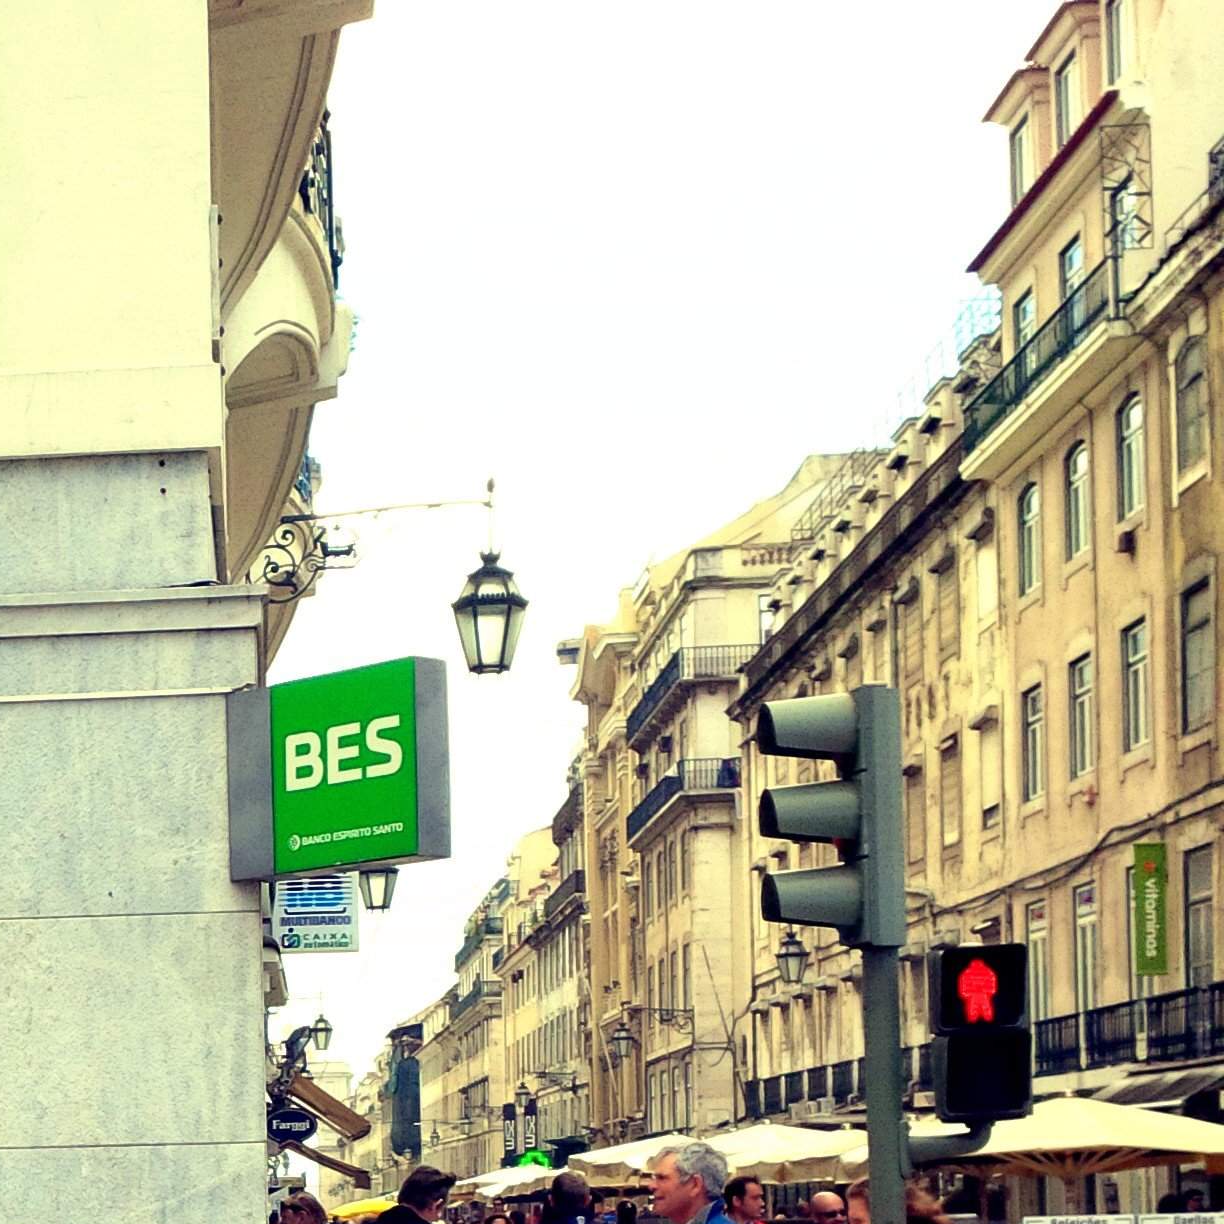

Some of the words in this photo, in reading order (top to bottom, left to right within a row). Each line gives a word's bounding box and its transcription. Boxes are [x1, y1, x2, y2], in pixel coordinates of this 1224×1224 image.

[285, 714, 403, 792] BES
[302, 833, 331, 846] BANCO
[333, 827, 371, 841] ESPIRITO
[373, 822, 403, 835] SANTO
[280, 916, 351, 926] MULTIBANCO
